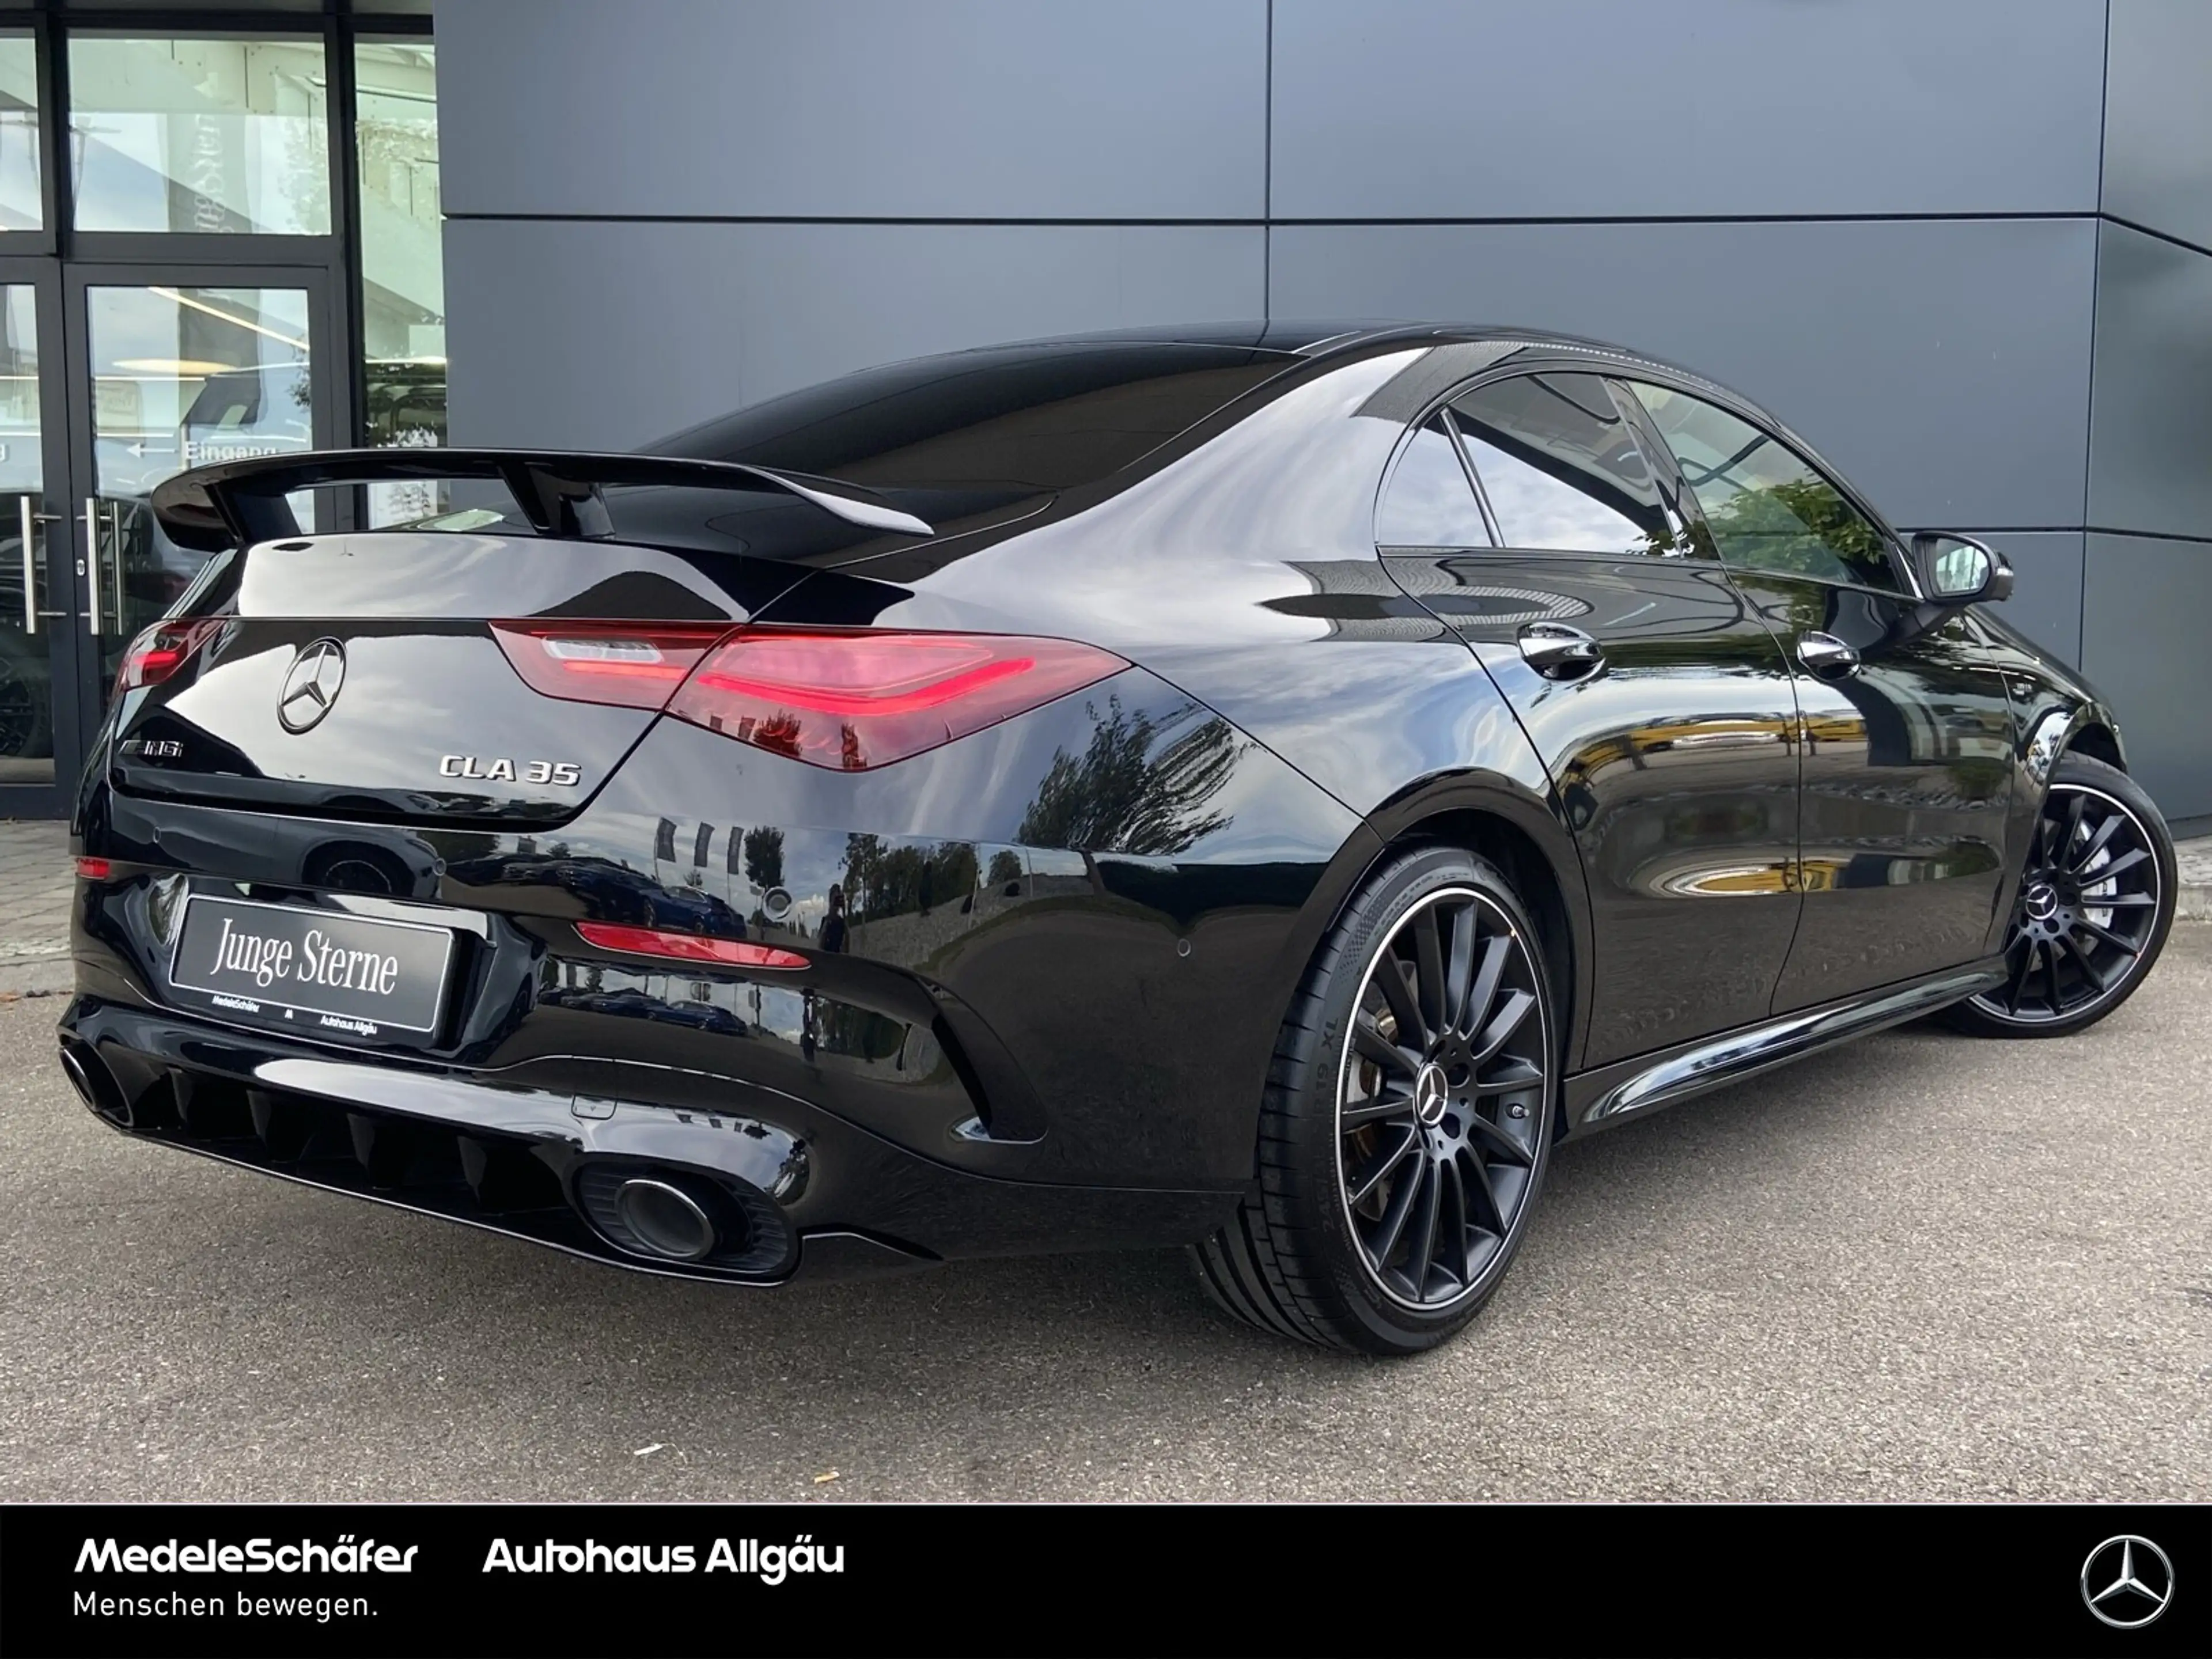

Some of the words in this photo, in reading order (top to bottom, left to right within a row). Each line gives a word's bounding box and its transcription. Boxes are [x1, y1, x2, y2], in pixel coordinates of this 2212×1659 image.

[439, 754, 516, 783] CLA
[525, 760, 581, 786] 35
[210, 918, 293, 988] Junge
[297, 929, 398, 996] Sterne
[320, 1014, 353, 1031] Autohaus
